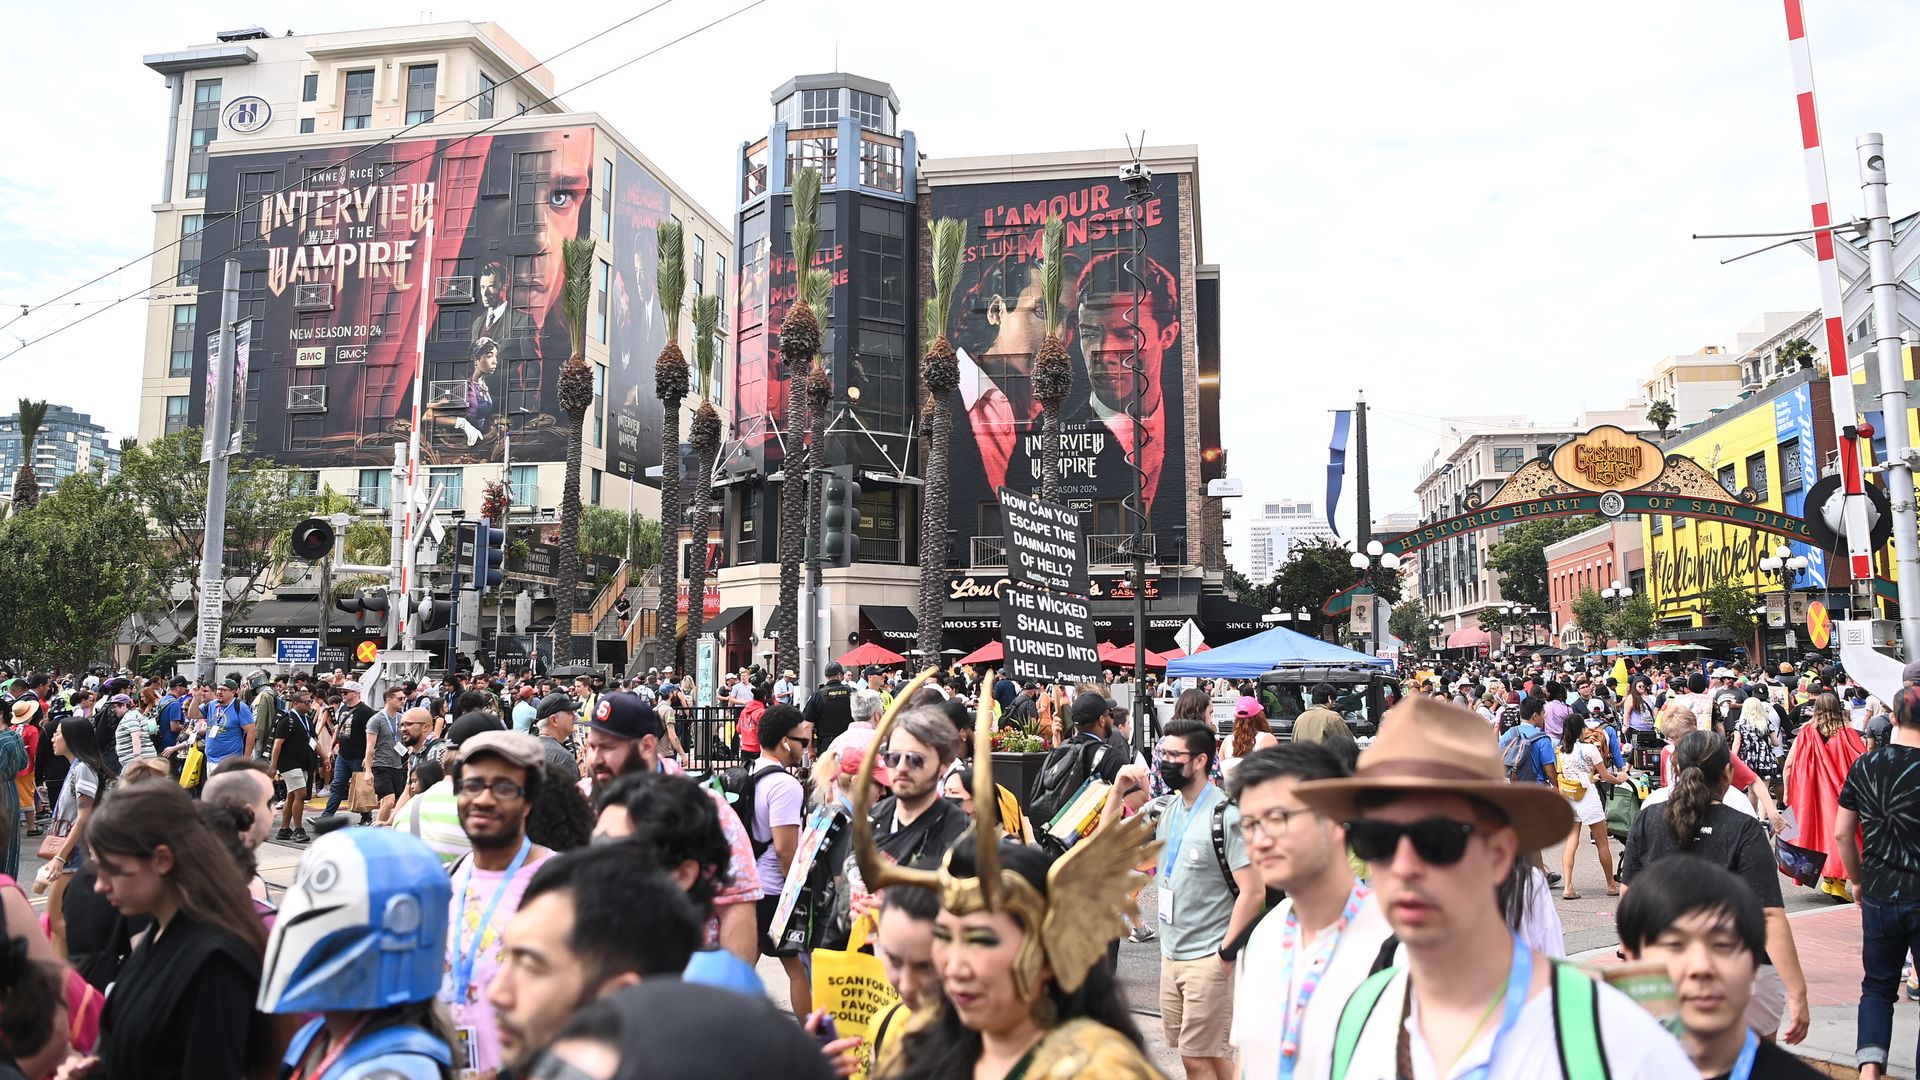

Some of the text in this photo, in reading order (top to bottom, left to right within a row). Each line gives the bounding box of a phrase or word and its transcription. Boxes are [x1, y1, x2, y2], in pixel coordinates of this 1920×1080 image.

[311, 171, 338, 183] ANNE
[260, 181, 436, 244] INTERVIEW
[984, 184, 1111, 241] L'AMOUR
[308, 225, 375, 242] WITH THE
[992, 238, 1014, 256] UN
[1017, 198, 1163, 264] MNSTRE
[267, 239, 417, 298] VAMPIRE
[776, 244, 844, 276] FAILLE
[769, 268, 849, 306] MORE
[289, 325, 382, 340] NEW SEASON 2024
[1024, 433, 1105, 458] INRVIEW
[1030, 456, 1098, 480] VMPIRE
[1057, 485, 1079, 494] ASON
[1079, 484, 1098, 493] 2024
[1000, 490, 1079, 527] HOW CAN YOU
[1008, 511, 1077, 543] ESCAPE THE
[1400, 497, 1810, 550] HISTORIC HEART OF SAN DIEG
[1013, 530, 1076, 561] DAMNATION
[1020, 551, 1073, 577] OF HELL?
[949, 577, 993, 600] Lou
[1051, 576, 1069, 588] 23:33
[1110, 588, 1159, 597] GASLMP
[1005, 588, 1035, 609] THE
[1036, 594, 1088, 619] WICKED
[244, 626, 276, 634] STEAKS
[942, 620, 1002, 629] MOUS STE
[1016, 613, 1085, 640] SHALL BE
[1255, 621, 1275, 629] 1945
[1005, 635, 1098, 663] TURNED INTO
[569, 658, 591, 666] VERSE
[1013, 658, 1097, 684] HELL. Psalm 9:17
[828, 976, 864, 986] SCAN
[866, 979, 885, 991] FOR
[841, 988, 864, 998] OFF
